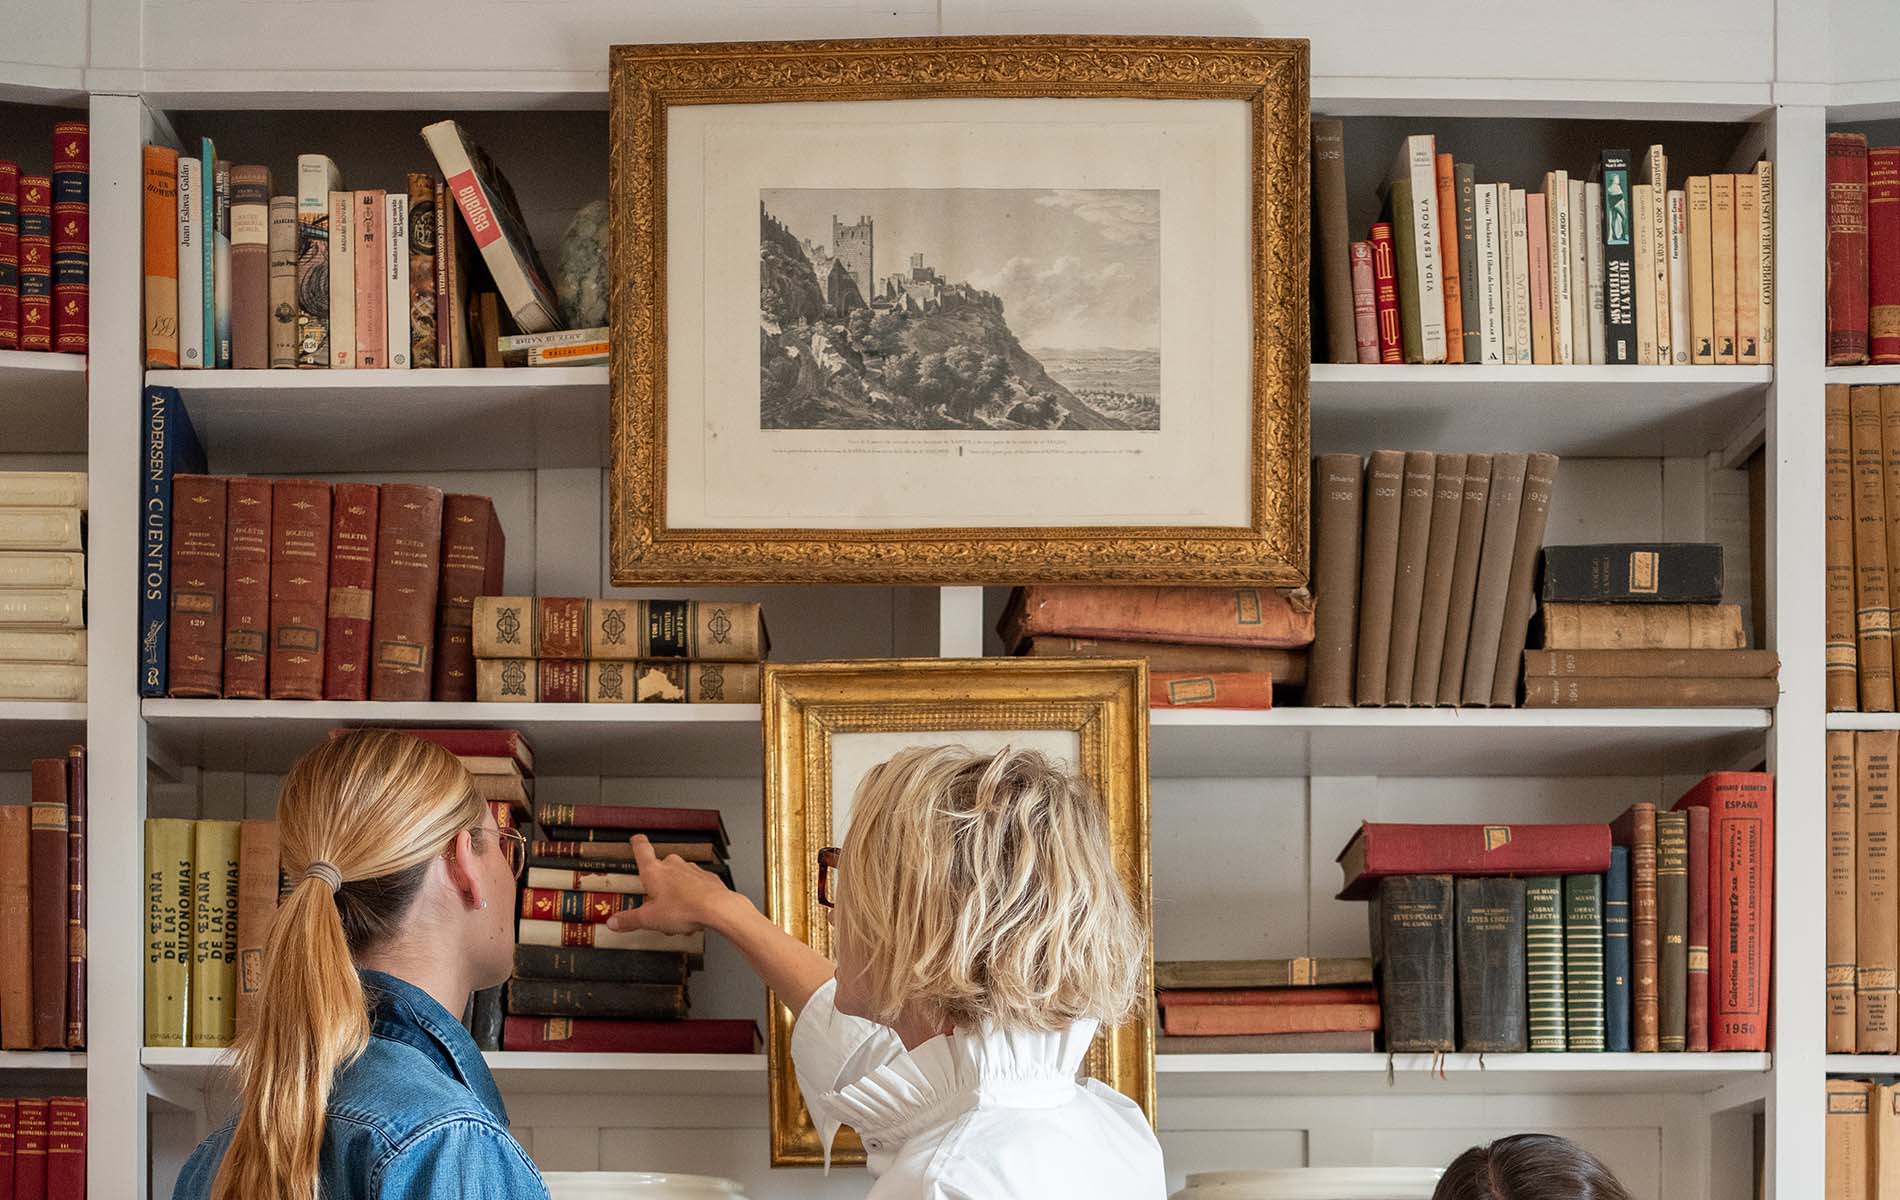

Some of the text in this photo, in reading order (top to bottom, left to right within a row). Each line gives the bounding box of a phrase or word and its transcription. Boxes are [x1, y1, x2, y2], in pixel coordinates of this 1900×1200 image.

[180, 164, 191, 247] Juan Eslava Galán
[1463, 176, 1473, 240] RELATOS
[1761, 166, 1771, 204] PADRES
[1762, 206, 1771, 224] LOS
[1420, 198, 1434, 292] VIDA ESPAÑOLA
[1559, 212, 1567, 237] JUEGO
[1609, 260, 1621, 324] MIS ESTRELLAS
[1620, 260, 1631, 324] DE LA SUERTE
[1761, 234, 1772, 305] COMPRENDER
[151, 394, 164, 481] ANDERSEN
[147, 497, 163, 601] CUENTOS
[1724, 800, 1759, 809] ESPAÑA
[149, 871, 162, 964] LA ESPAÑA
[163, 907, 176, 960] DE LAS
[178, 860, 191, 964] AUTONOMIAS
[196, 871, 210, 964] LA ESPAÑA
[211, 907, 223, 960] DE LAS
[225, 860, 238, 964] AUTONOMIAS
[1728, 959, 1738, 1007] Calcetines
[1724, 1023, 1755, 1034] 1950
